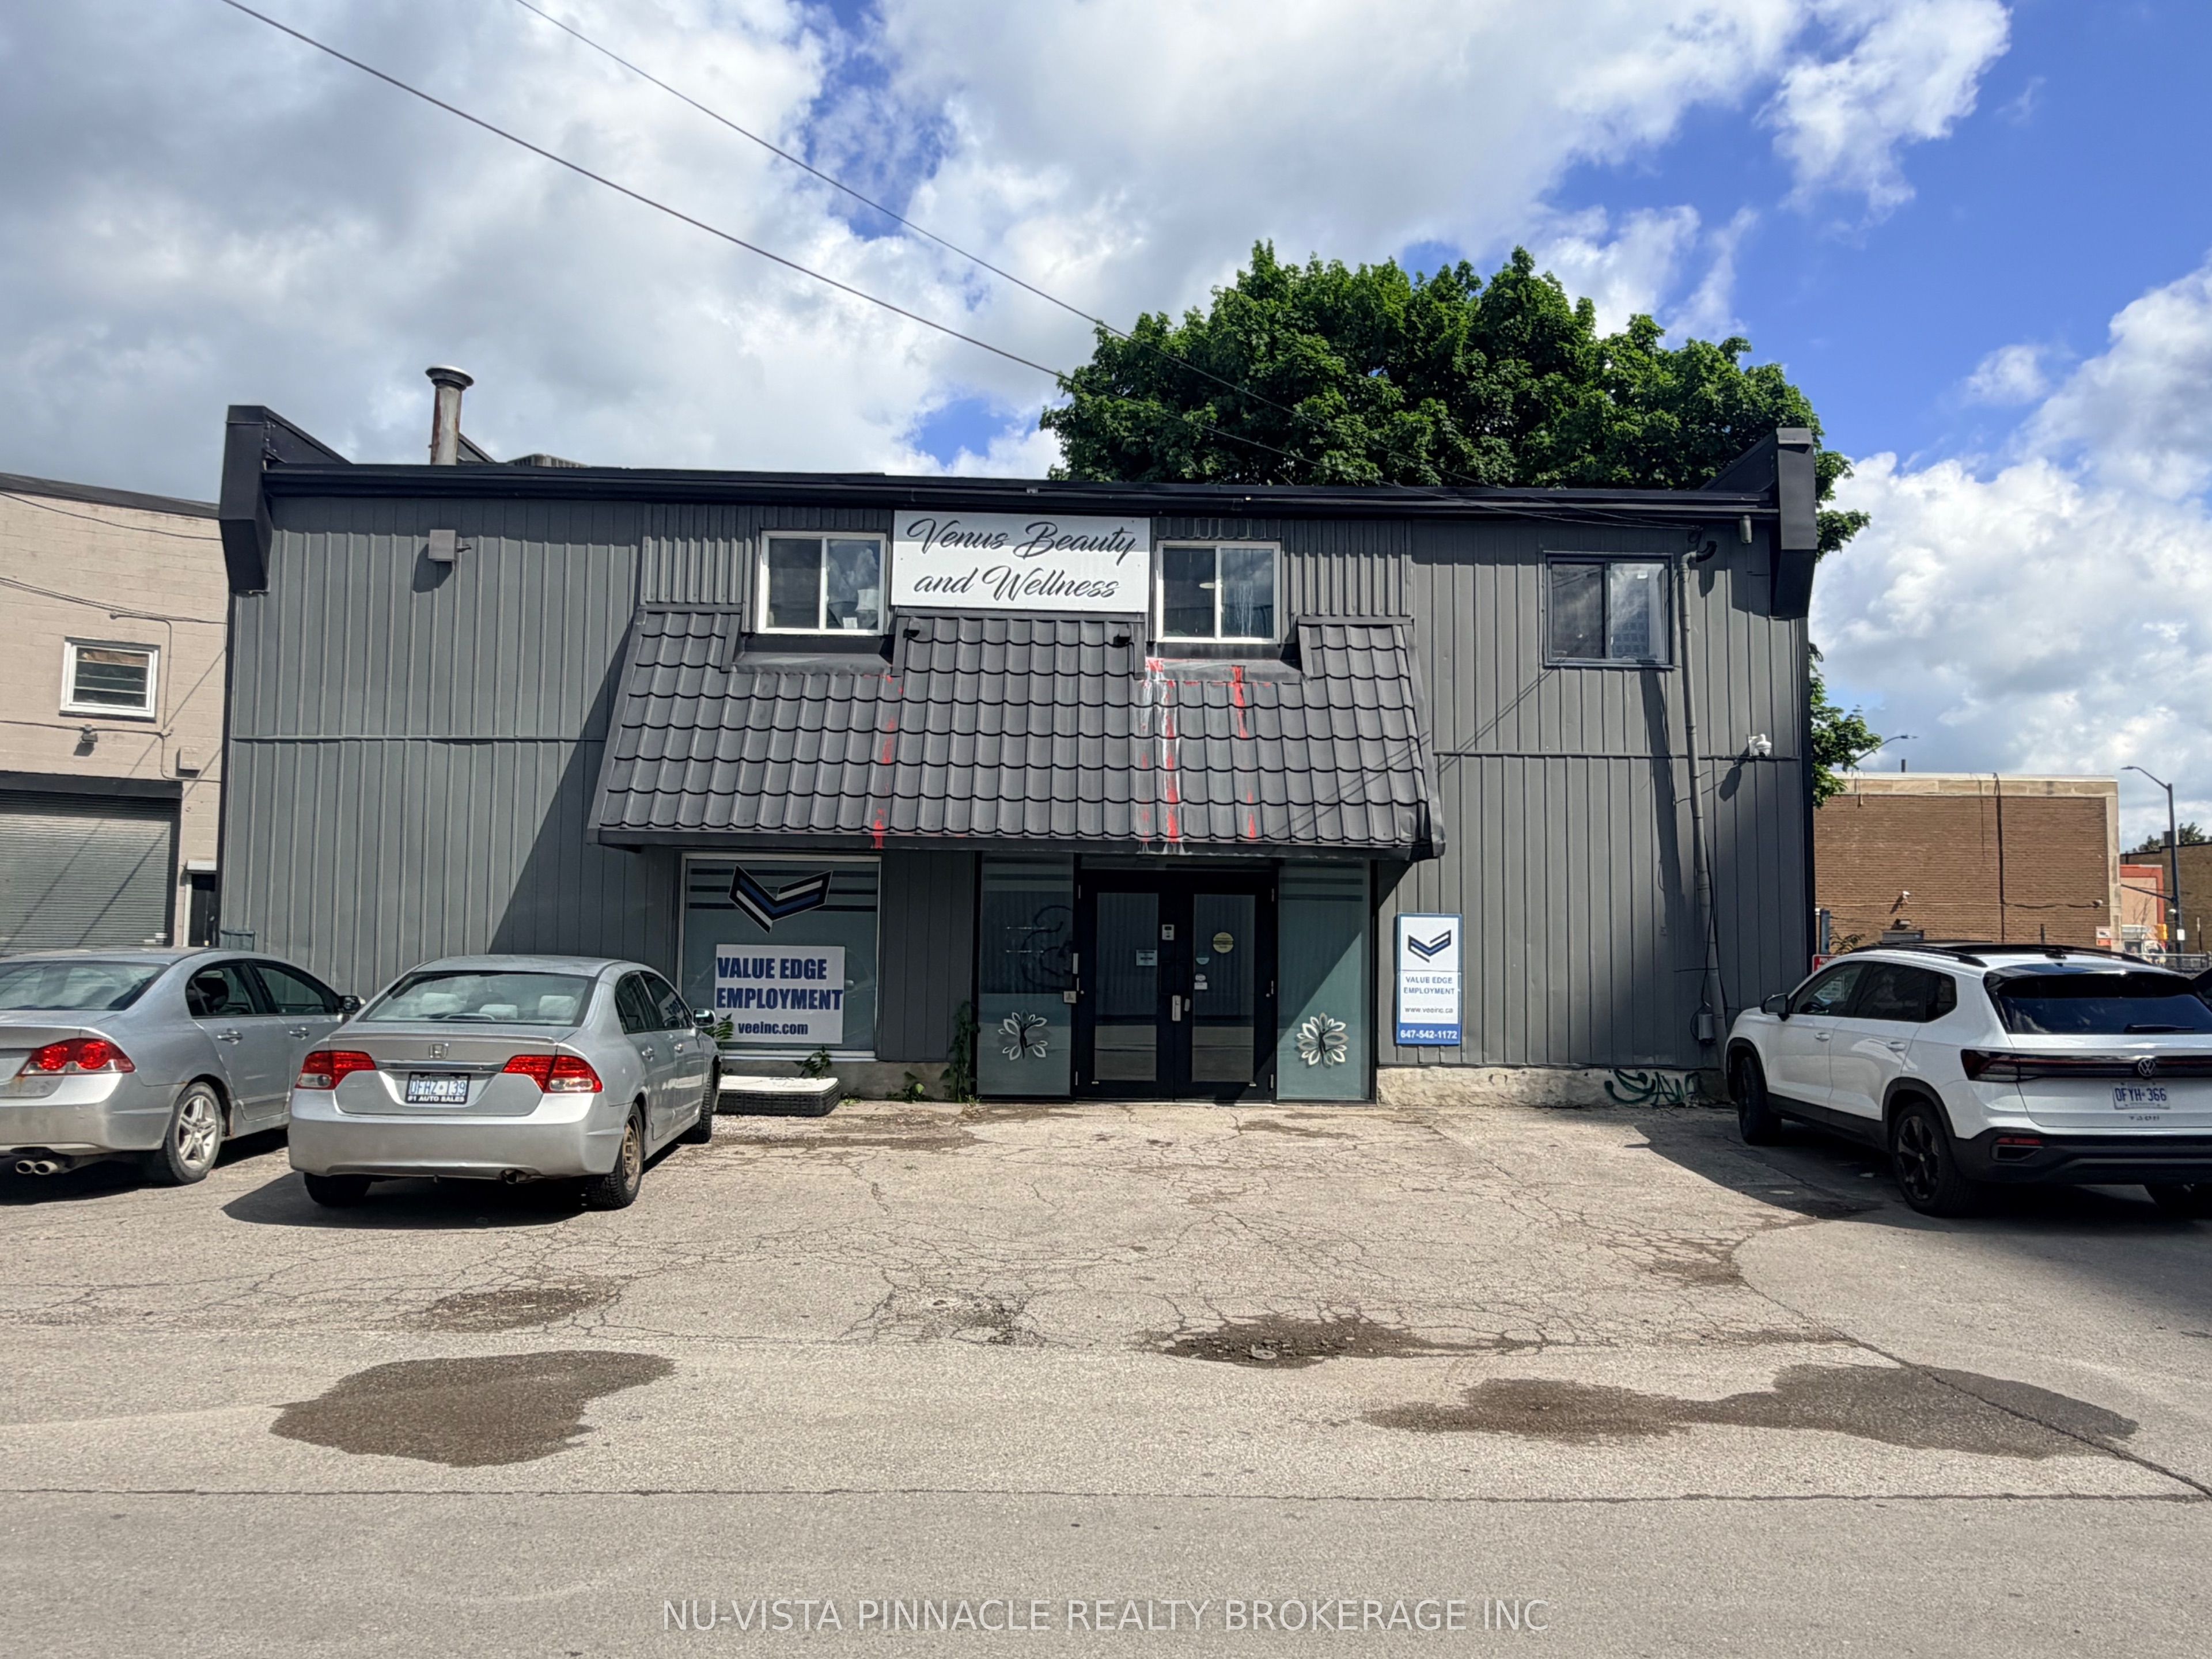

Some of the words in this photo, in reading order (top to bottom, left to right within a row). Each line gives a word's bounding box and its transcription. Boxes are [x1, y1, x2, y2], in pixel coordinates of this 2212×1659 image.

[907, 518, 1010, 555] Venus
[1013, 521, 1135, 566] Beauty
[914, 567, 978, 594] and
[982, 565, 1120, 601] Wellness
[717, 957, 775, 978] VALUE
[779, 959, 827, 979] EDGE
[716, 987, 843, 1010] EMPLOYMENT
[738, 1021, 808, 1035] veeinc.com
[1400, 1029, 1457, 1039] 647-542-1172
[2146, 1088, 2167, 1101] 366
